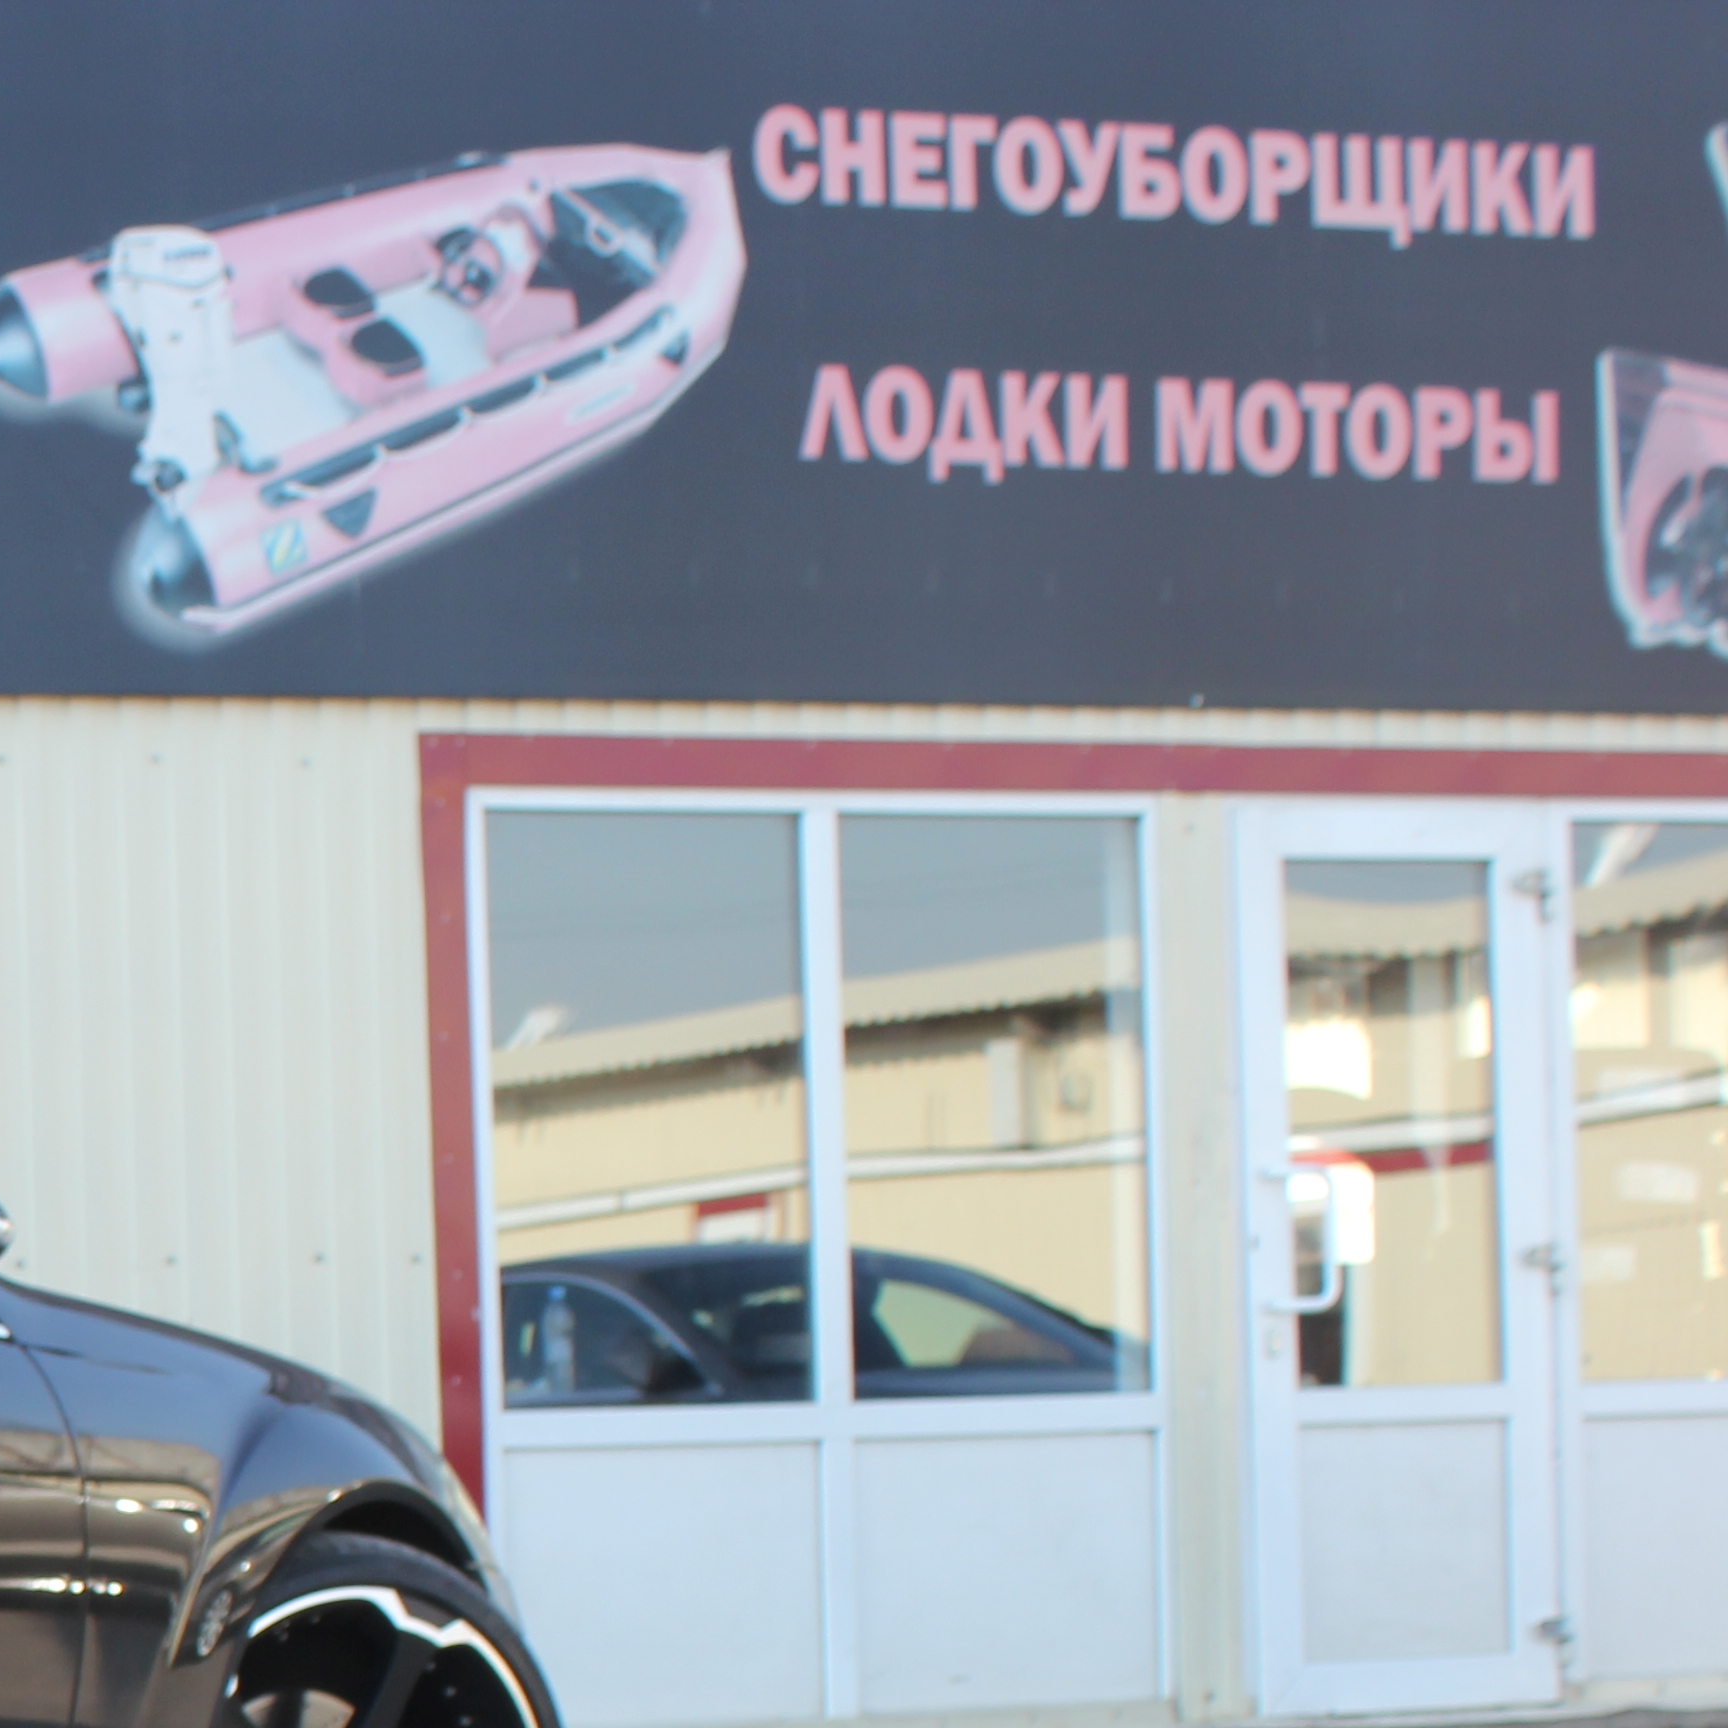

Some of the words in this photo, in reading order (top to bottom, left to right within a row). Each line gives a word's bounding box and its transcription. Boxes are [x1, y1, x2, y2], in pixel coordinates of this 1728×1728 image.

[752, 104, 1595, 249] СНЕГОУБОРЩИКИ
[799, 364, 1129, 485] ЛОДКИ
[1154, 375, 1560, 485] МОТОРЫ
